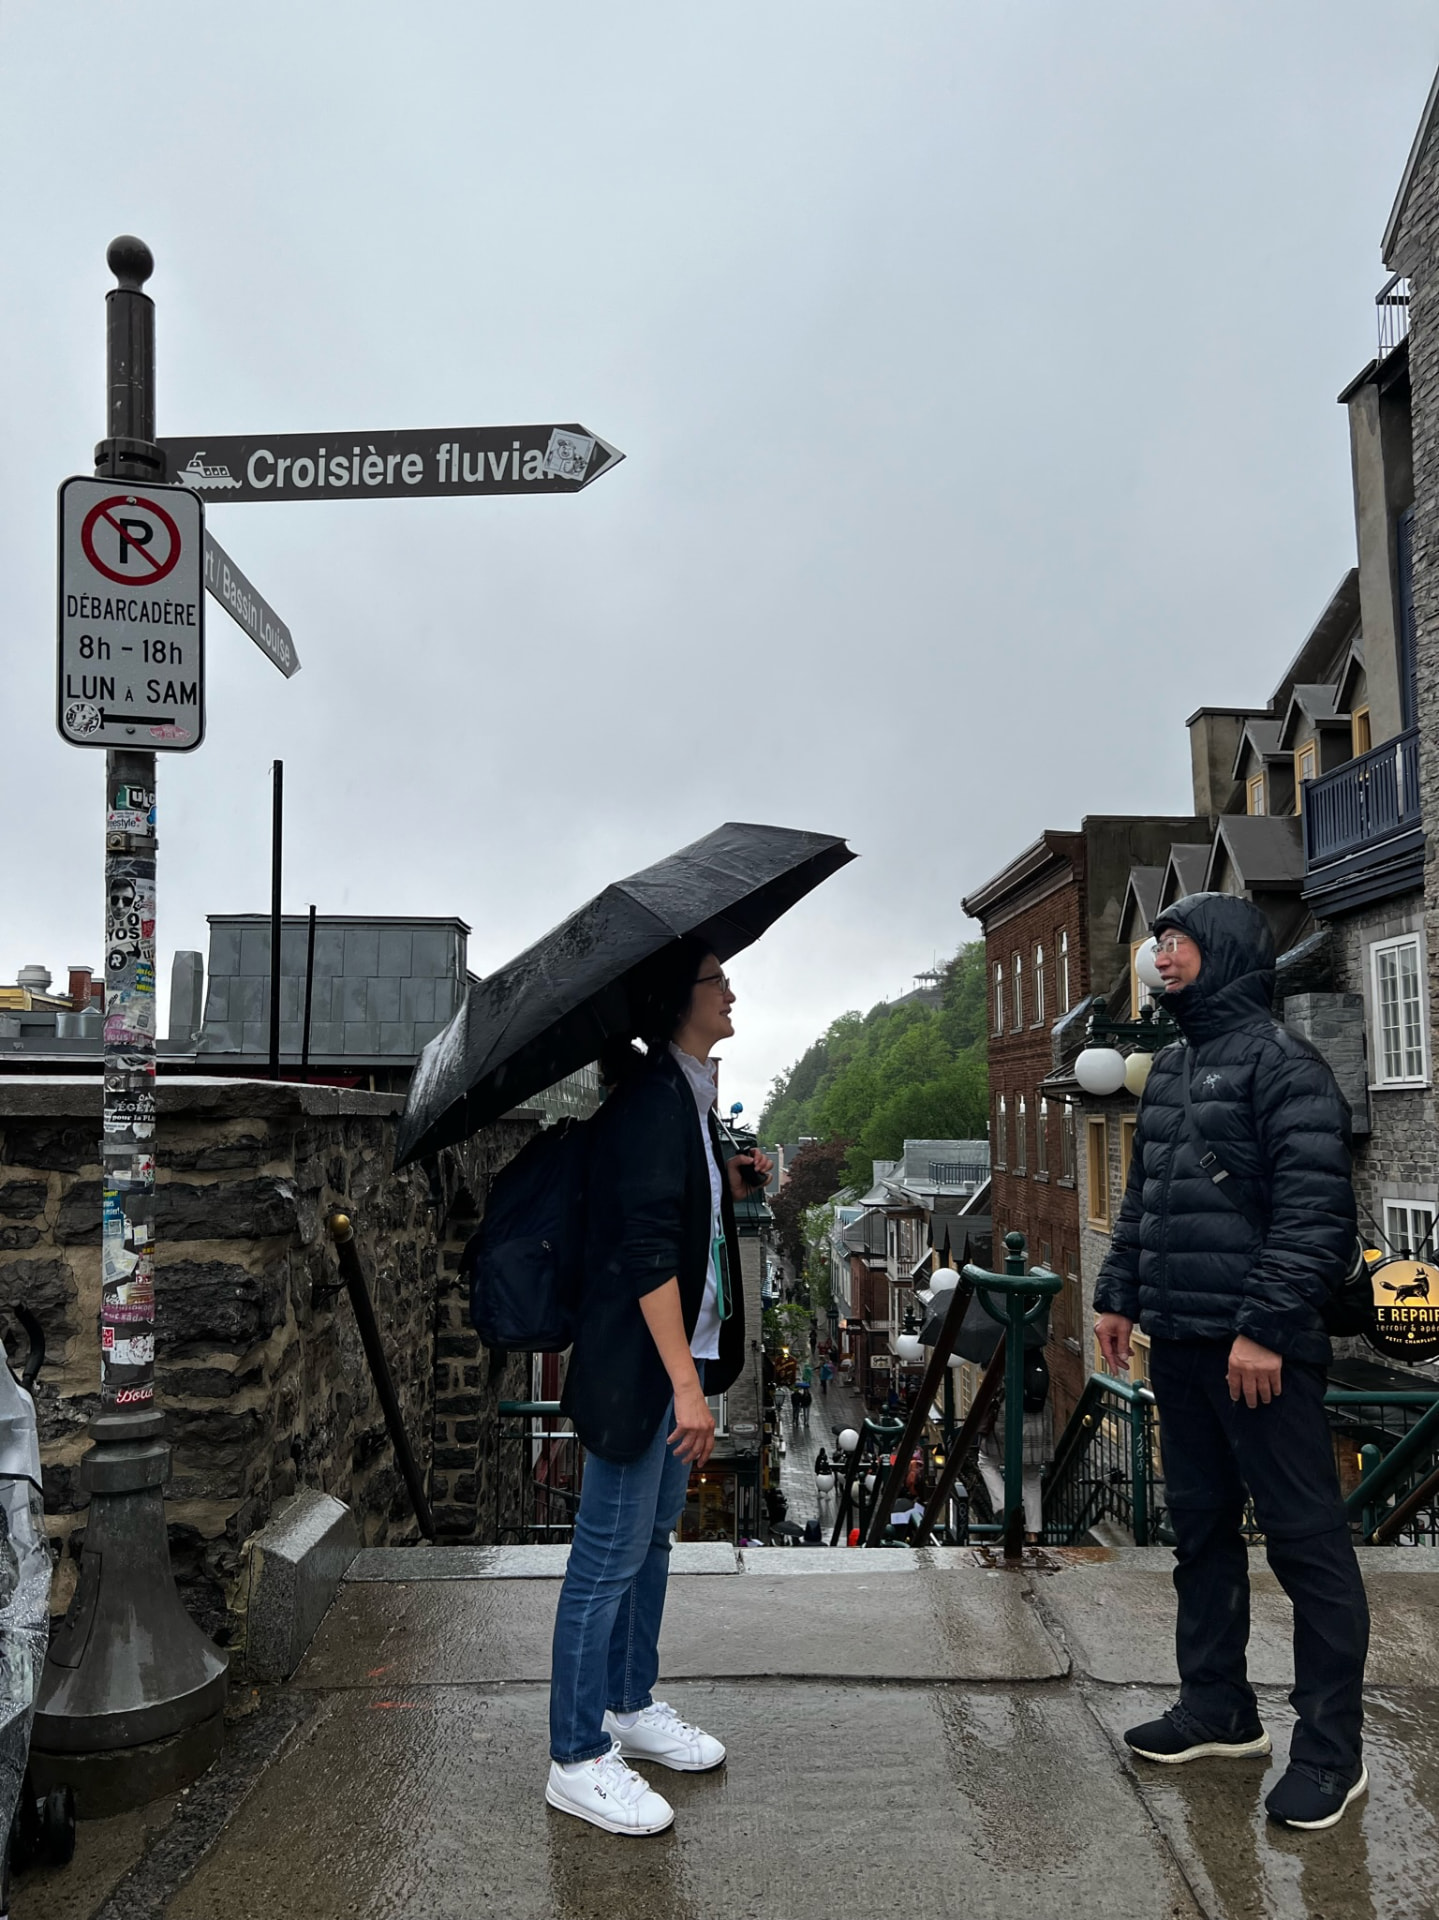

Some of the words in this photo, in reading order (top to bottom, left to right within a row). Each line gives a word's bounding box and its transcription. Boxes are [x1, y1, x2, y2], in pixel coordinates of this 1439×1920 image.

[247, 445, 424, 489] Croisière
[436, 440, 571, 483] fluvia
[66, 593, 197, 627] DÉBARCADÈRE
[222, 562, 258, 632] Bassin
[259, 607, 291, 668] Louise
[79, 635, 111, 661] 8h
[142, 638, 183, 665] 18h
[66, 674, 115, 701] LUN
[124, 686, 134, 702] À
[146, 679, 198, 706] SAM
[111, 1114, 133, 1122] pour
[1376, 1324, 1407, 1332] terroir
[1385, 1335, 1403, 1343] PETIT
[593, 1784, 607, 1800] FILA
